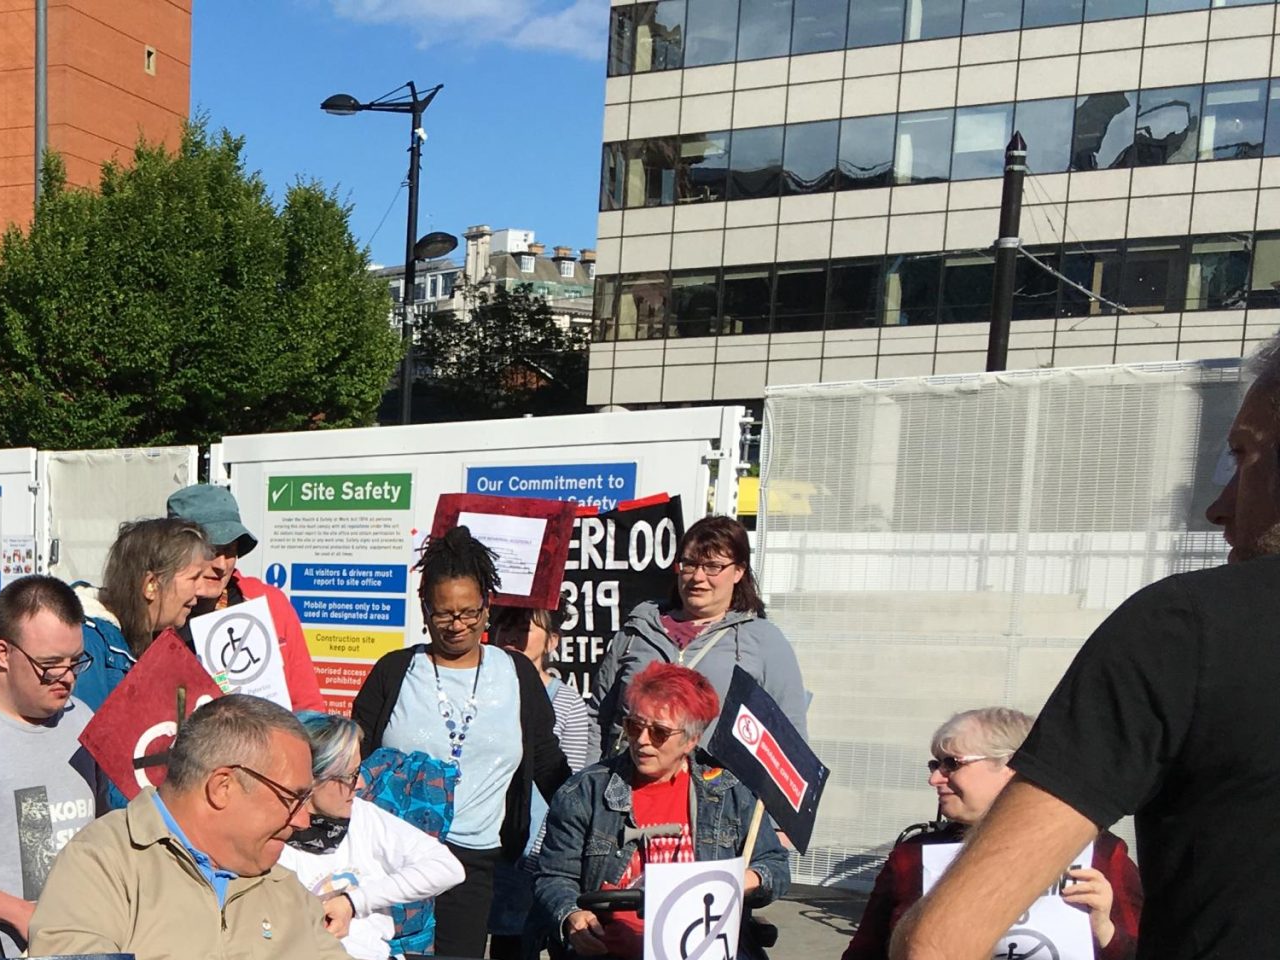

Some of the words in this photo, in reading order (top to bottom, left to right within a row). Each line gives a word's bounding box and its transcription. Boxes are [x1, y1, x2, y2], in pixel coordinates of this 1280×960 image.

[477, 476, 503, 491] Our
[508, 475, 602, 490] Commitment
[608, 474, 624, 488] to
[301, 482, 335, 500] Site
[341, 481, 401, 503] Safety
[348, 569, 373, 577] drivers
[361, 578, 382, 586] office
[304, 601, 327, 609] Mobile
[328, 602, 353, 611] phones
[355, 602, 370, 612] only
[381, 602, 391, 611] be
[560, 580, 620, 632] 819
[330, 611, 368, 620] designated
[316, 634, 360, 643] Construction
[325, 676, 361, 685] prohibited
[343, 708, 352, 717] sit
